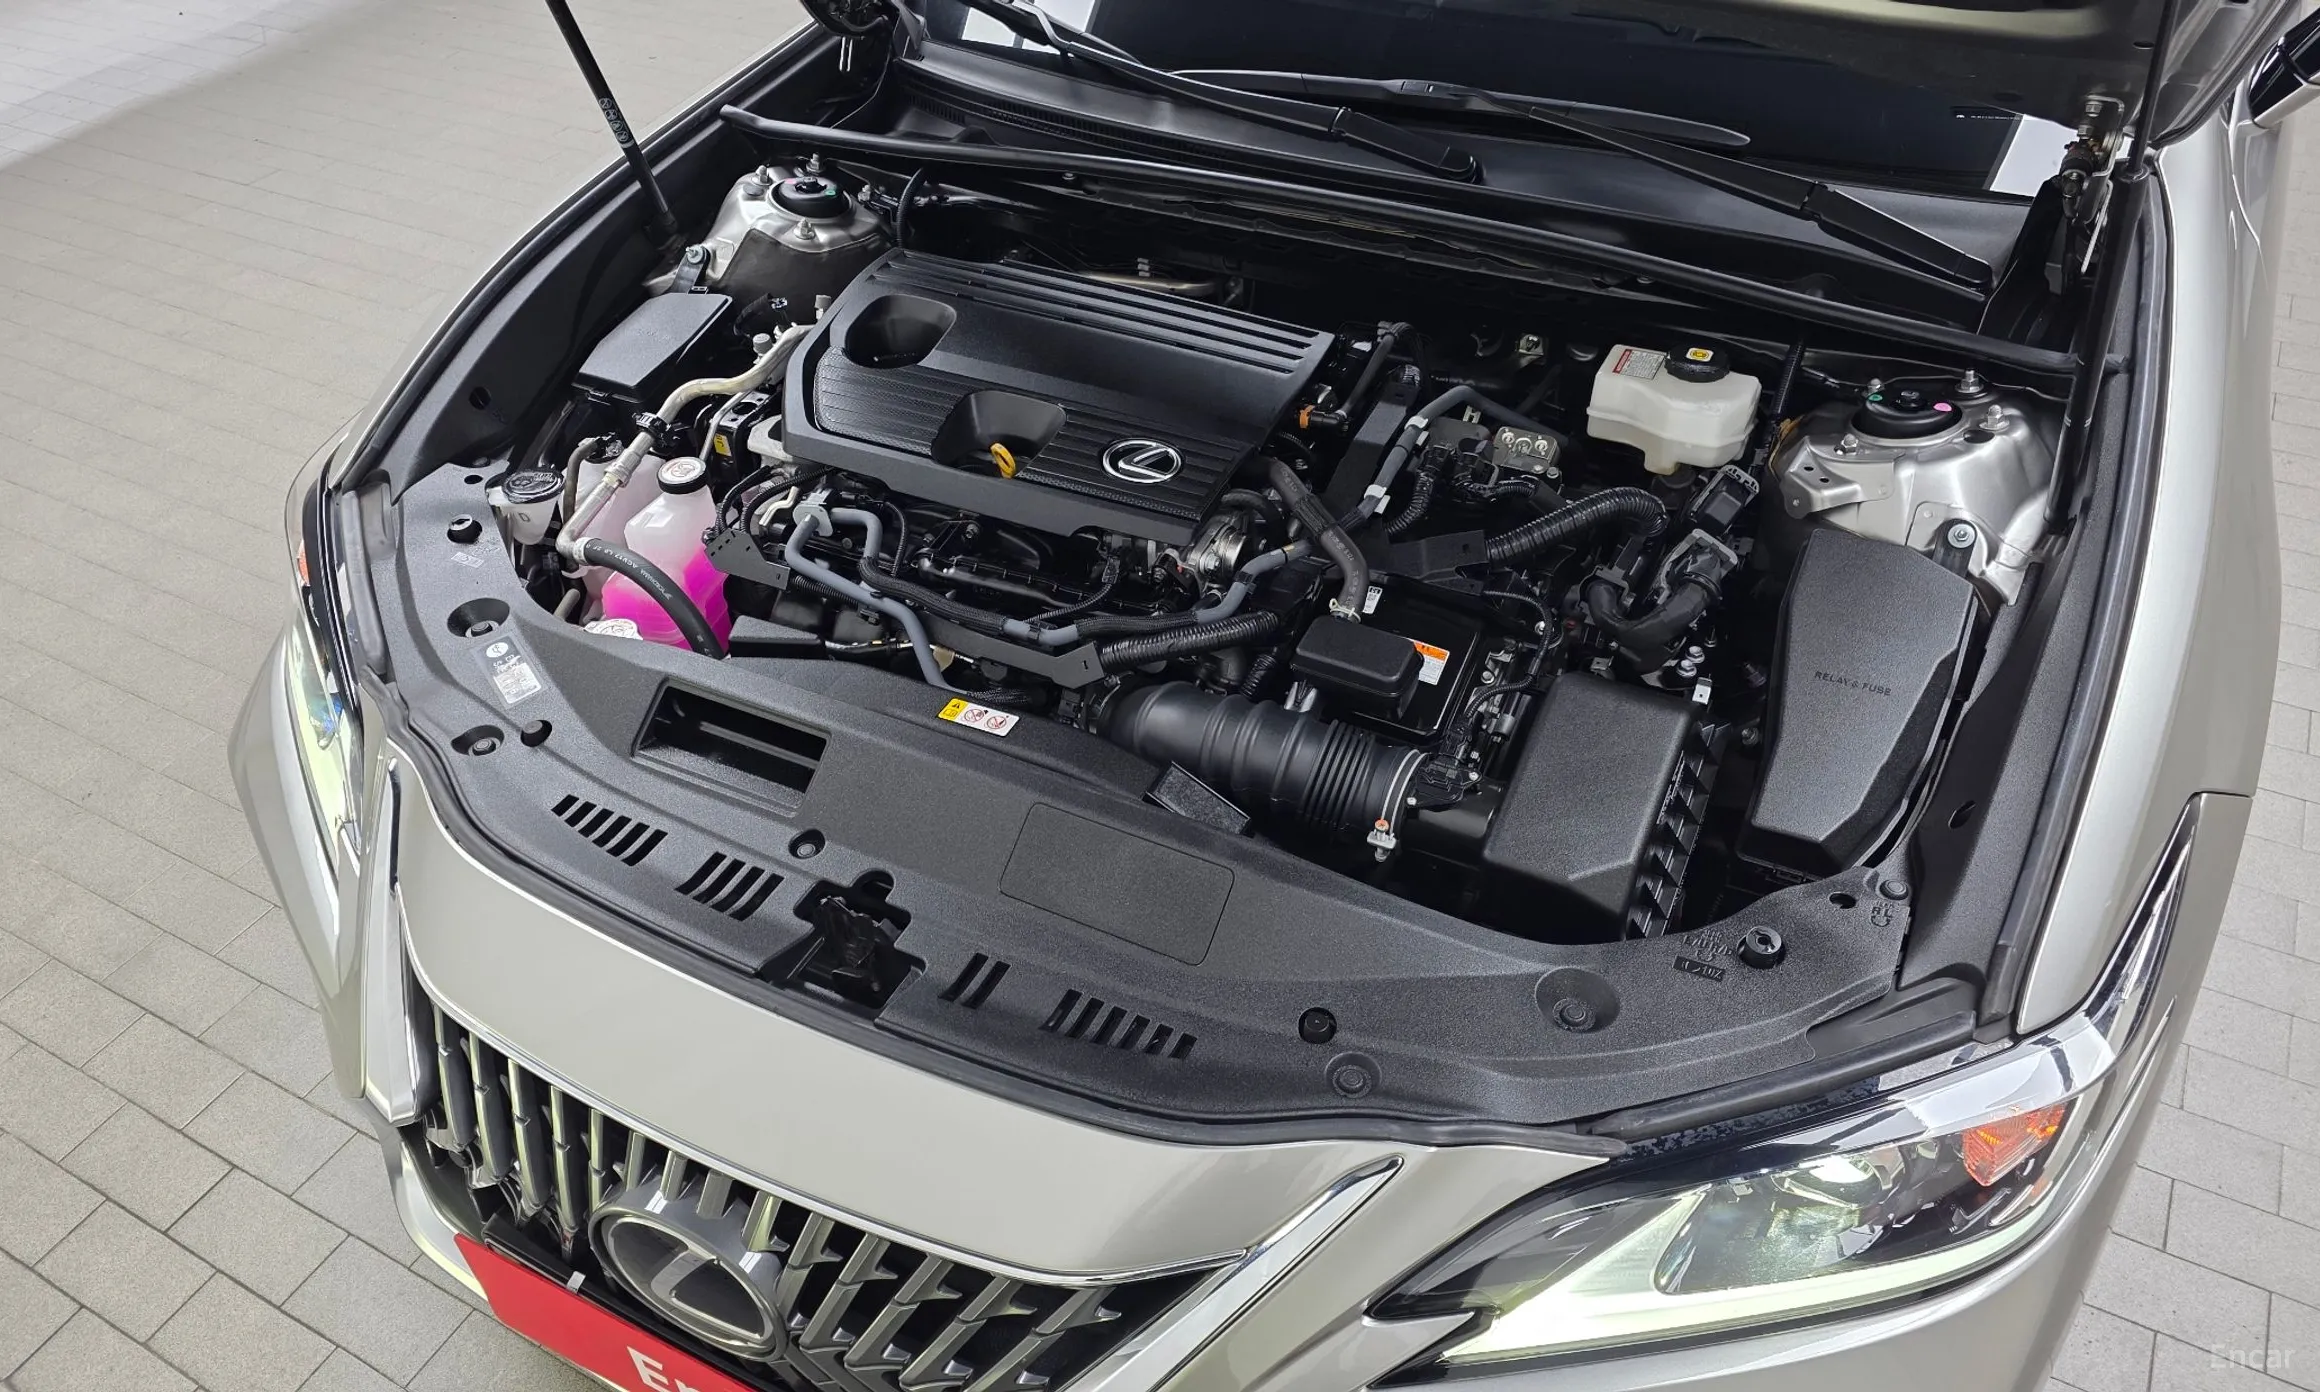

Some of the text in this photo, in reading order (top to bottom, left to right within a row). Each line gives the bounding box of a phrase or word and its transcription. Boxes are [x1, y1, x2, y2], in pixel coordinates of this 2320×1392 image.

[1814, 670, 1892, 697] RELAY & FUSE
